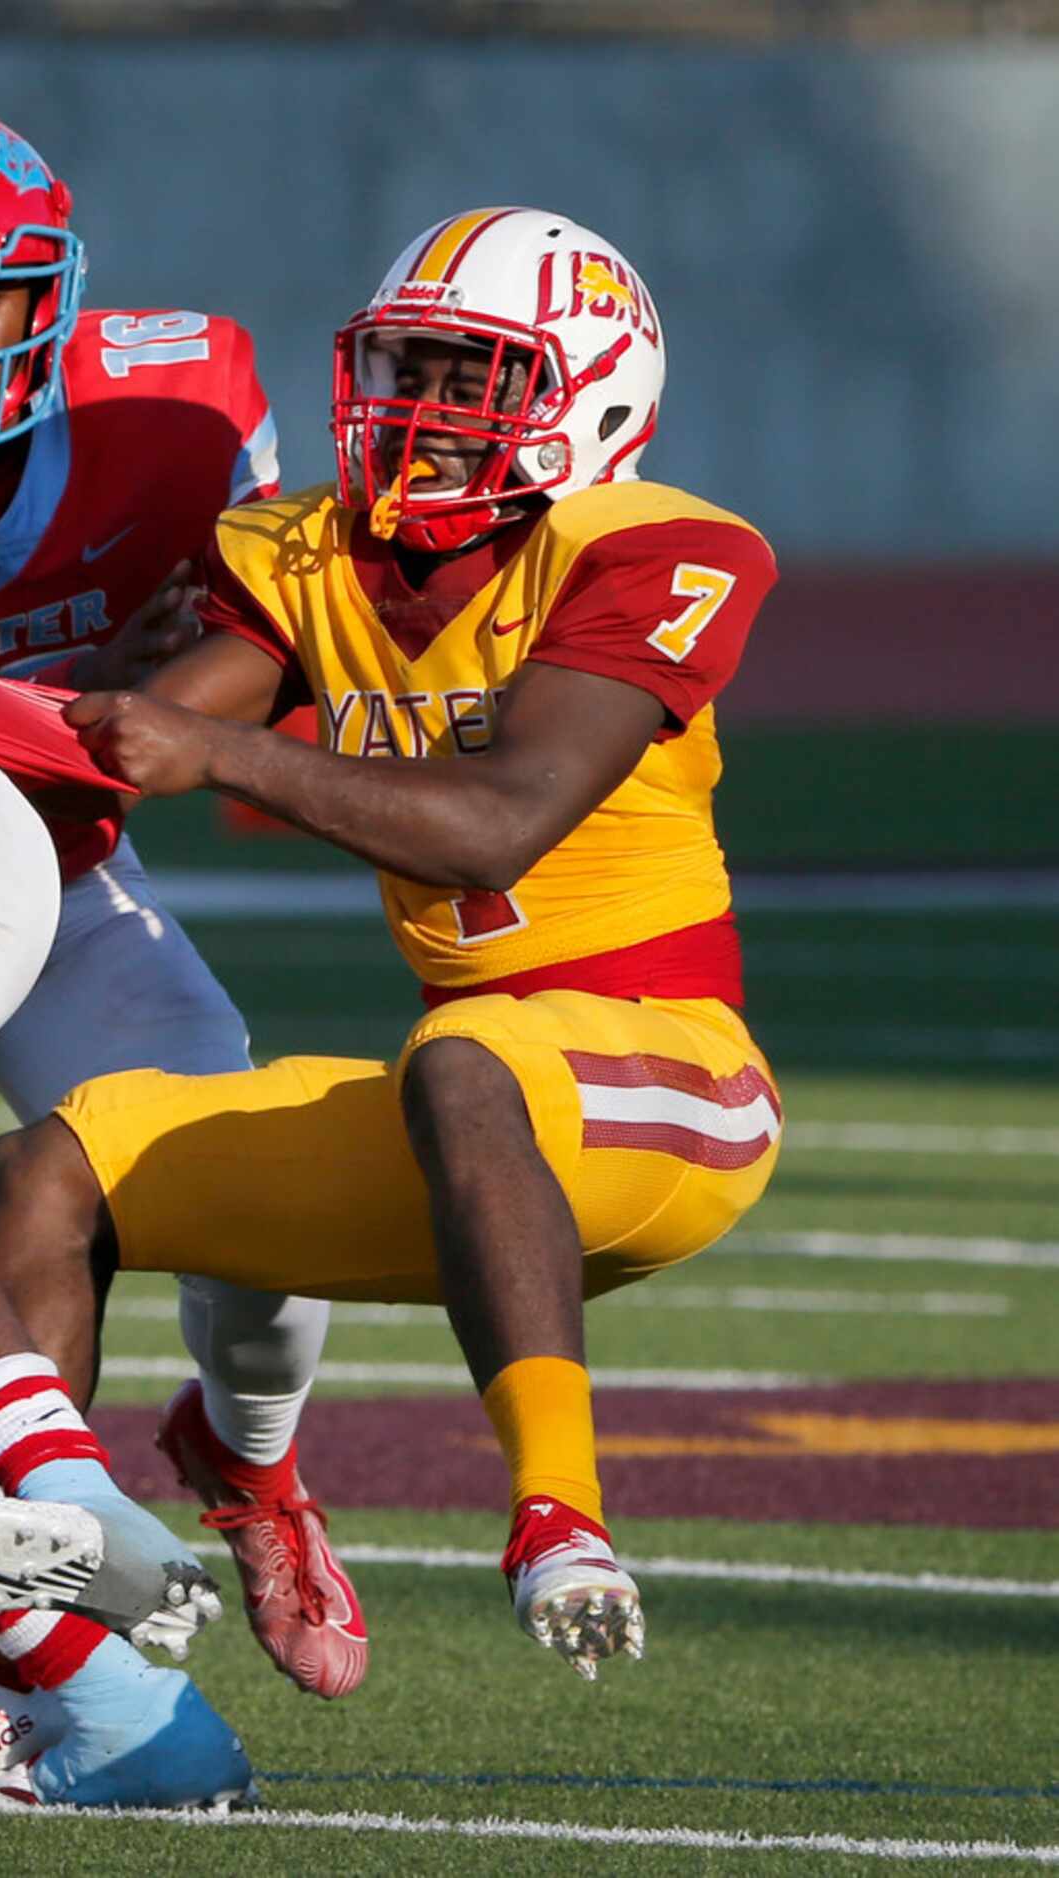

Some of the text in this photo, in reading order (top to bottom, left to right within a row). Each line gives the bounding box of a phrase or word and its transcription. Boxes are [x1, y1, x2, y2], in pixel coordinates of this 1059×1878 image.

[100, 310, 209, 378] 16
[644, 562, 737, 663] 7
[321, 688, 509, 758] YATE
